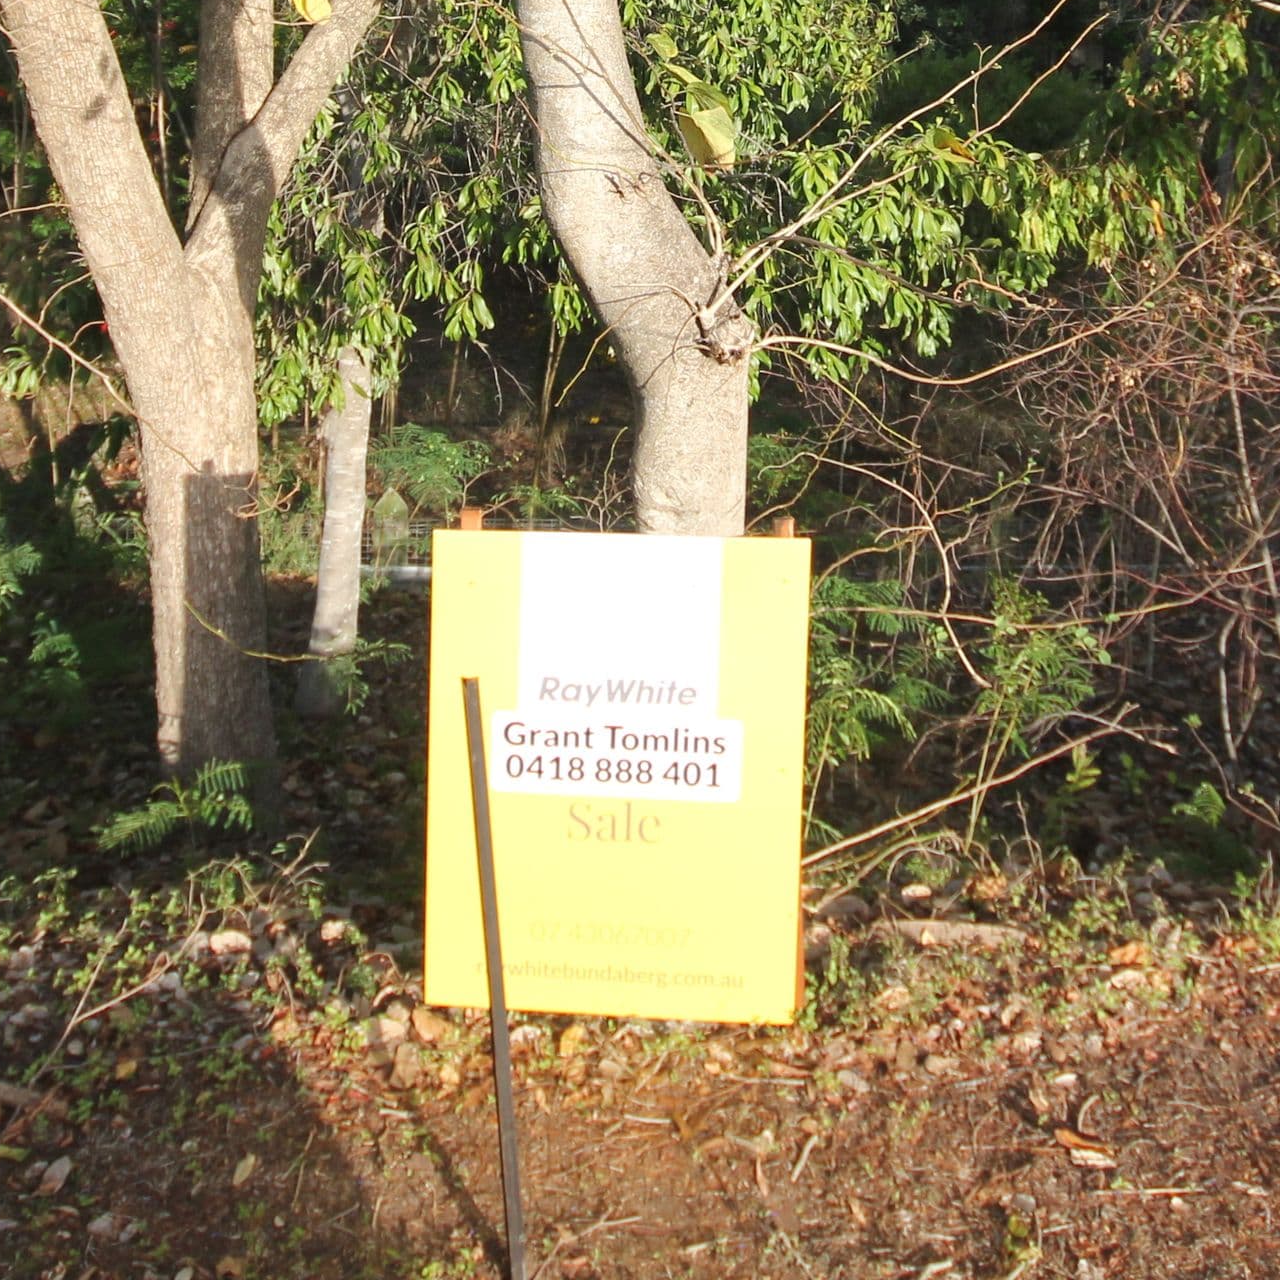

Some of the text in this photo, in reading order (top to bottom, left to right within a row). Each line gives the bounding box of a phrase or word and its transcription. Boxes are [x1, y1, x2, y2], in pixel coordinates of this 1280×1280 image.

[503, 721, 726, 754] Grant Tomlins
[505, 754, 721, 787] 0418 888 401
[567, 801, 661, 844] Sale
[476, 960, 744, 989] rwhitebundaberg.com.au
